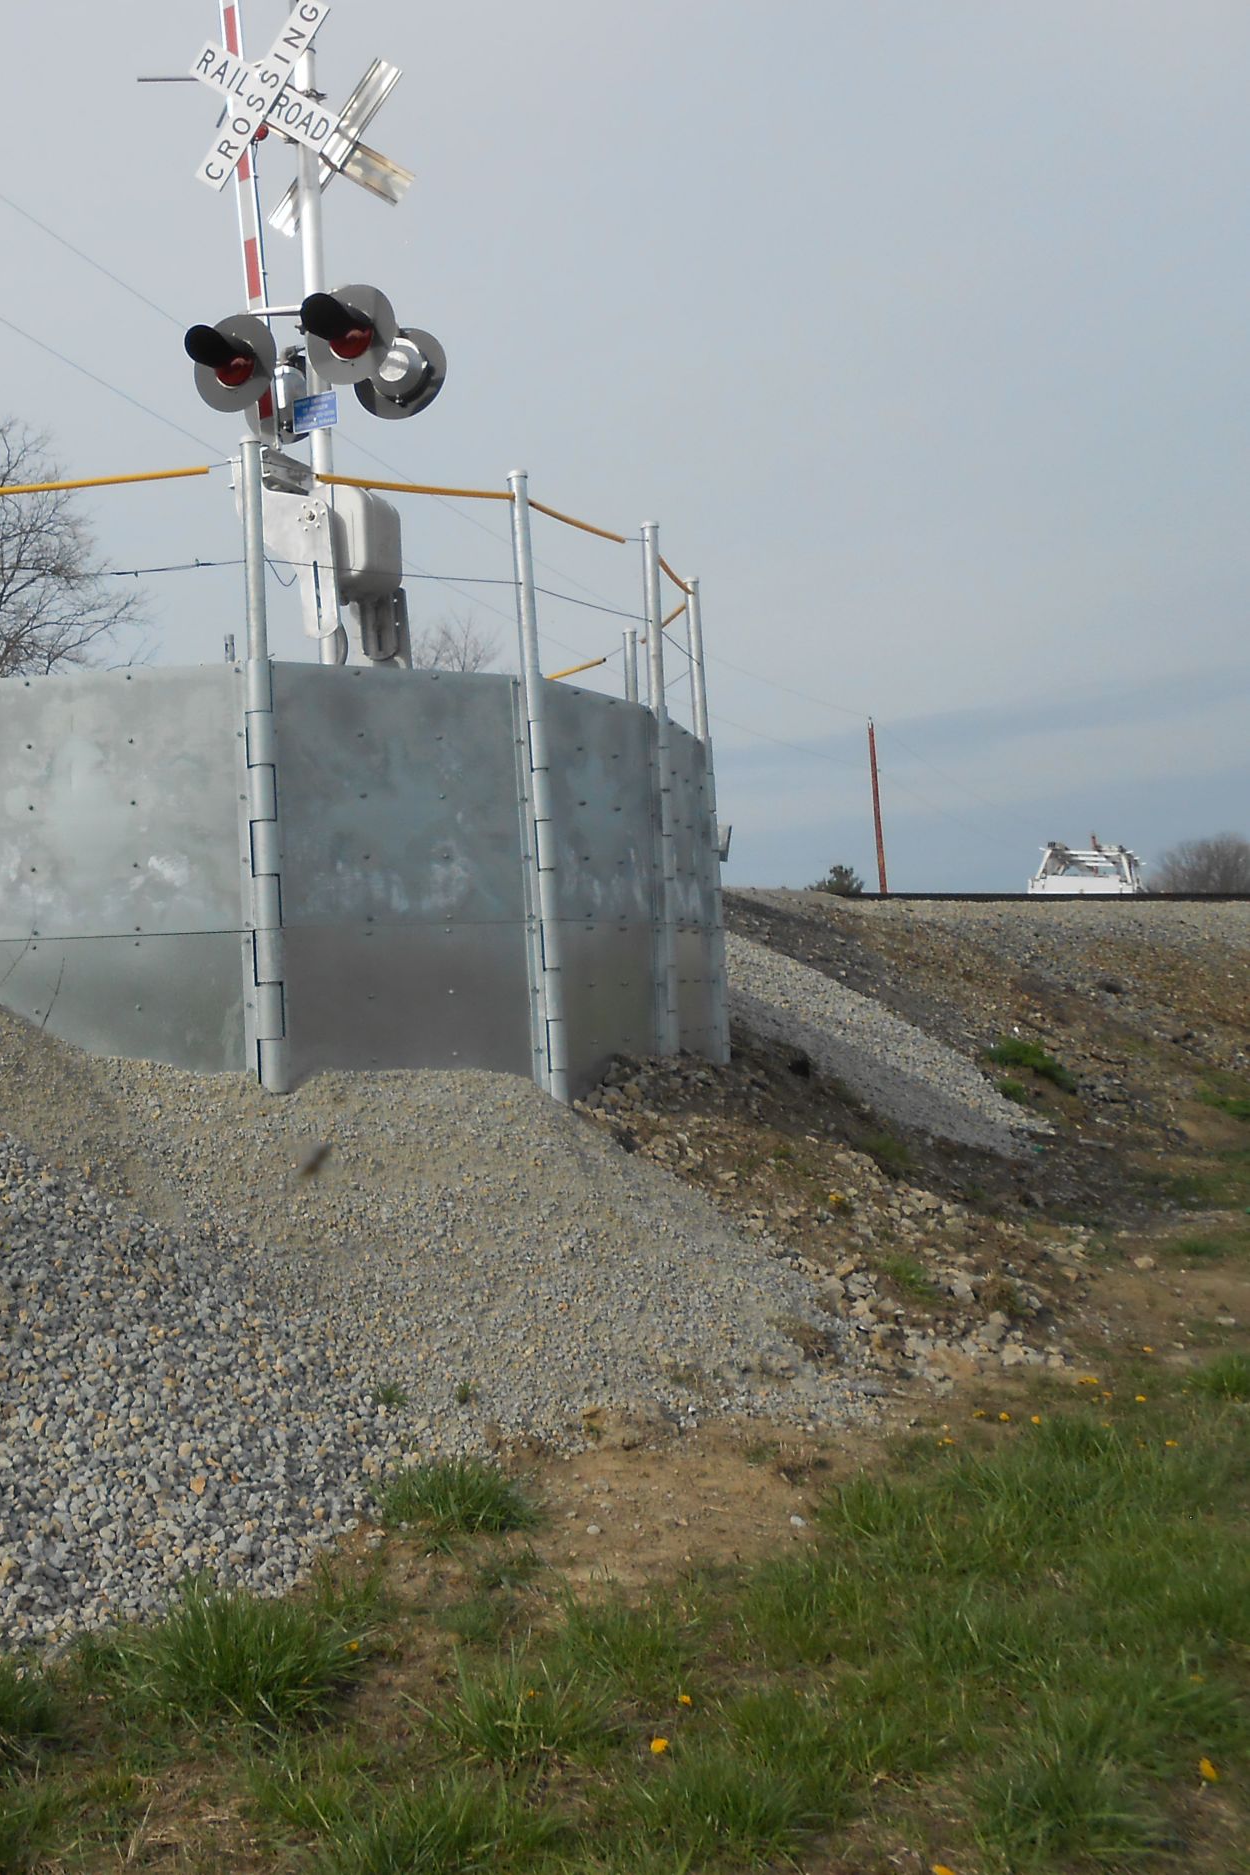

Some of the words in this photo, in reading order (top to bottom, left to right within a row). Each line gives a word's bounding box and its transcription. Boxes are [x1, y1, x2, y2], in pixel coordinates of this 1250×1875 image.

[196, 49, 249, 96] RAIL
[273, 94, 330, 142] ROAD
[205, 3, 319, 180] CROSSING
